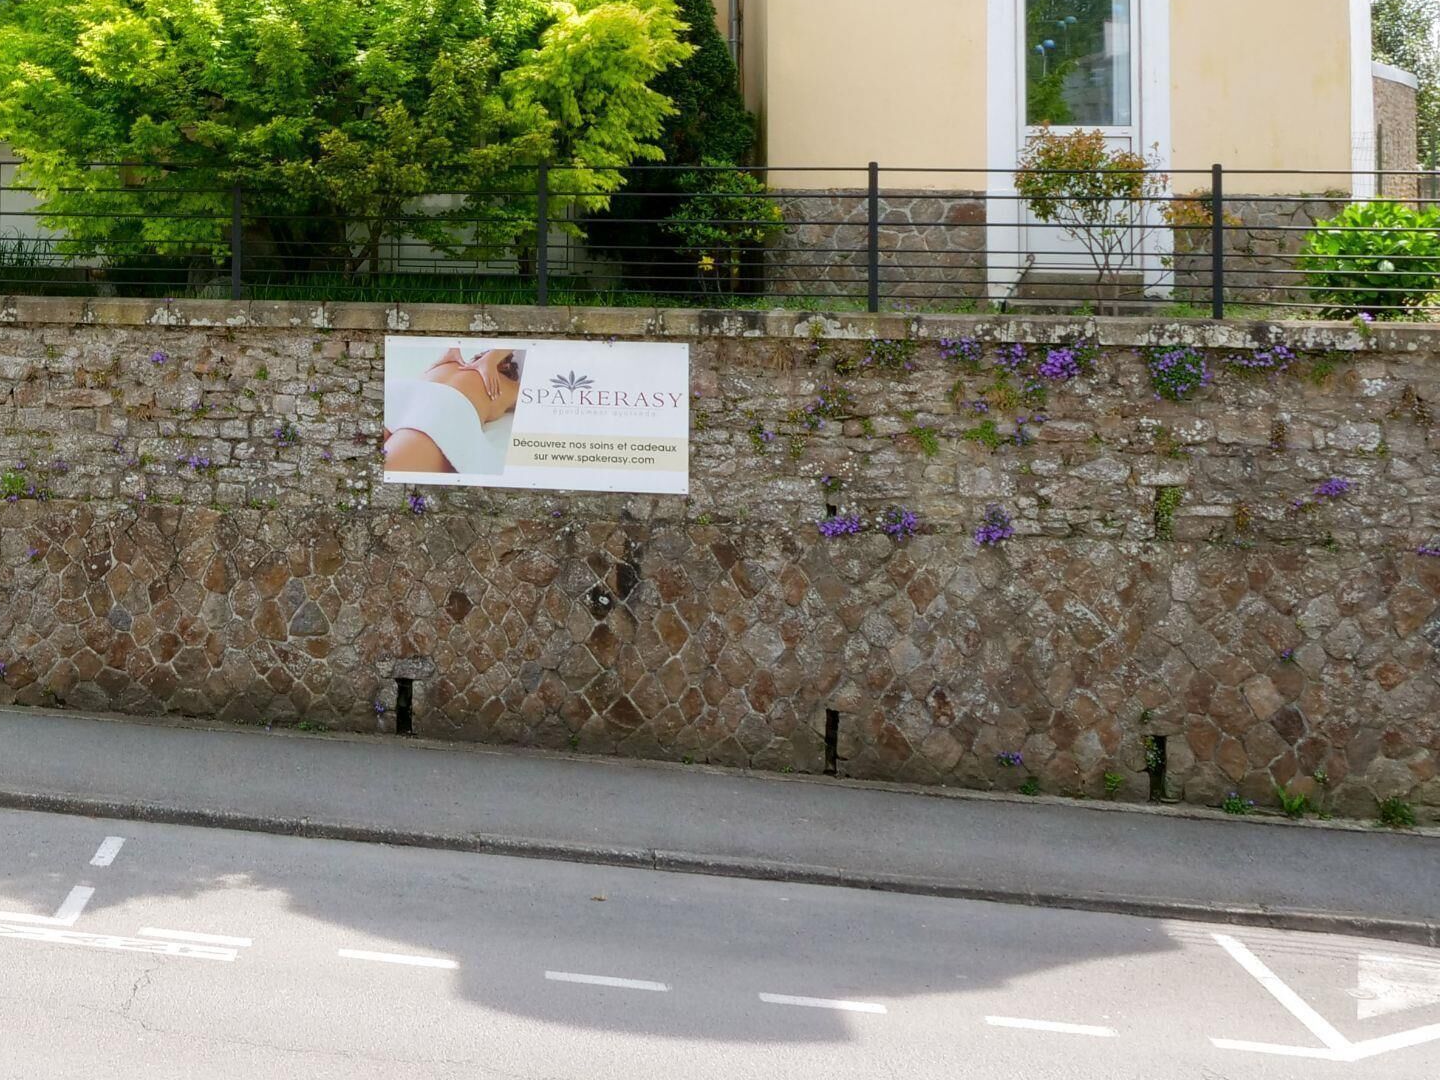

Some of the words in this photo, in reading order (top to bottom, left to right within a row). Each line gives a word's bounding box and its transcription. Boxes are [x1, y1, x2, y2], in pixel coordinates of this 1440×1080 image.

[521, 388, 566, 405] SPA
[579, 390, 683, 408] KERASY
[513, 438, 566, 449] Découvrez
[569, 441, 587, 450] nos
[589, 441, 614, 451] soins
[617, 442, 627, 451] et
[630, 442, 677, 452] cadeaux
[534, 453, 548, 461] sur
[551, 452, 655, 465] www.spakerasy.com
